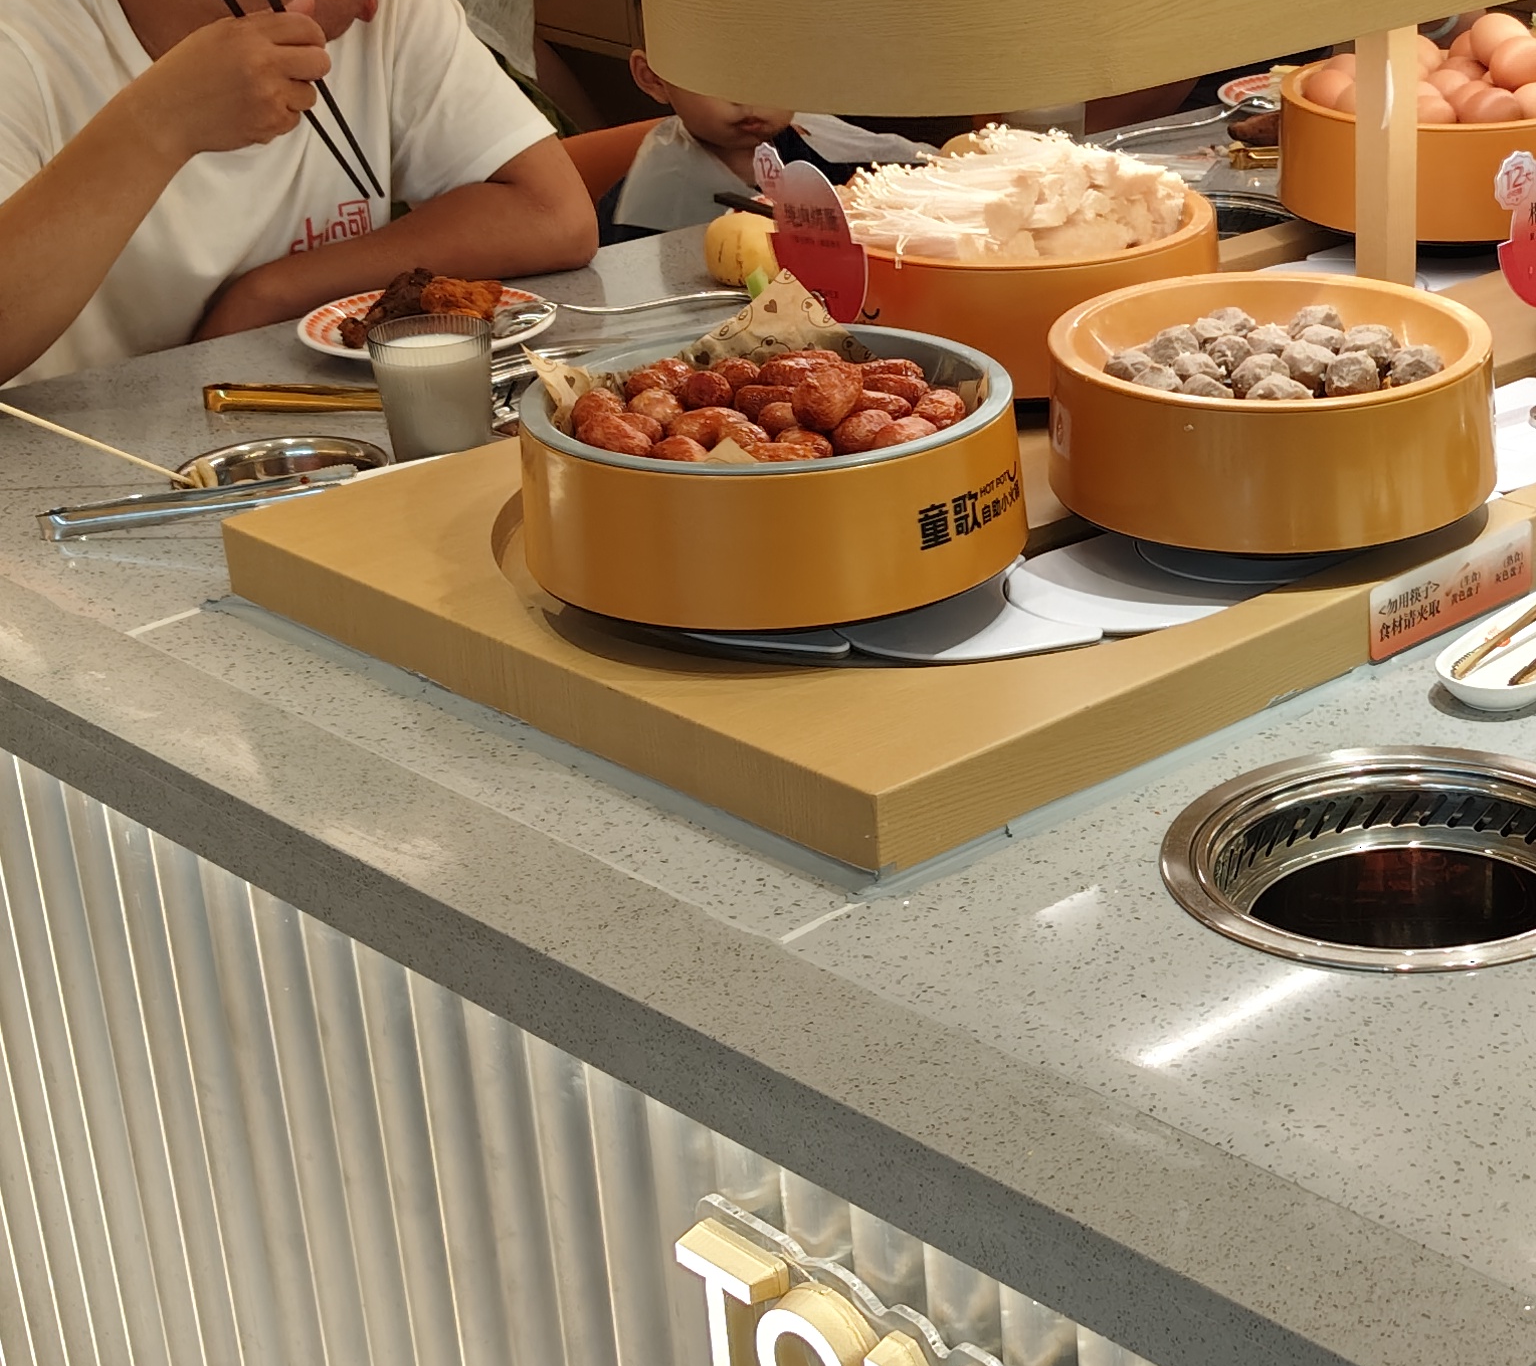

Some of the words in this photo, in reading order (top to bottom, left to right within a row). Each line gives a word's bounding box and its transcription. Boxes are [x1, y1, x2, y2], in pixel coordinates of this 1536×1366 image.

[980, 480, 995, 497] HOT
[982, 479, 1020, 526] 自助小火锅
[918, 491, 981, 551] 童歌
[1379, 599, 1442, 643] 食材请夹取
